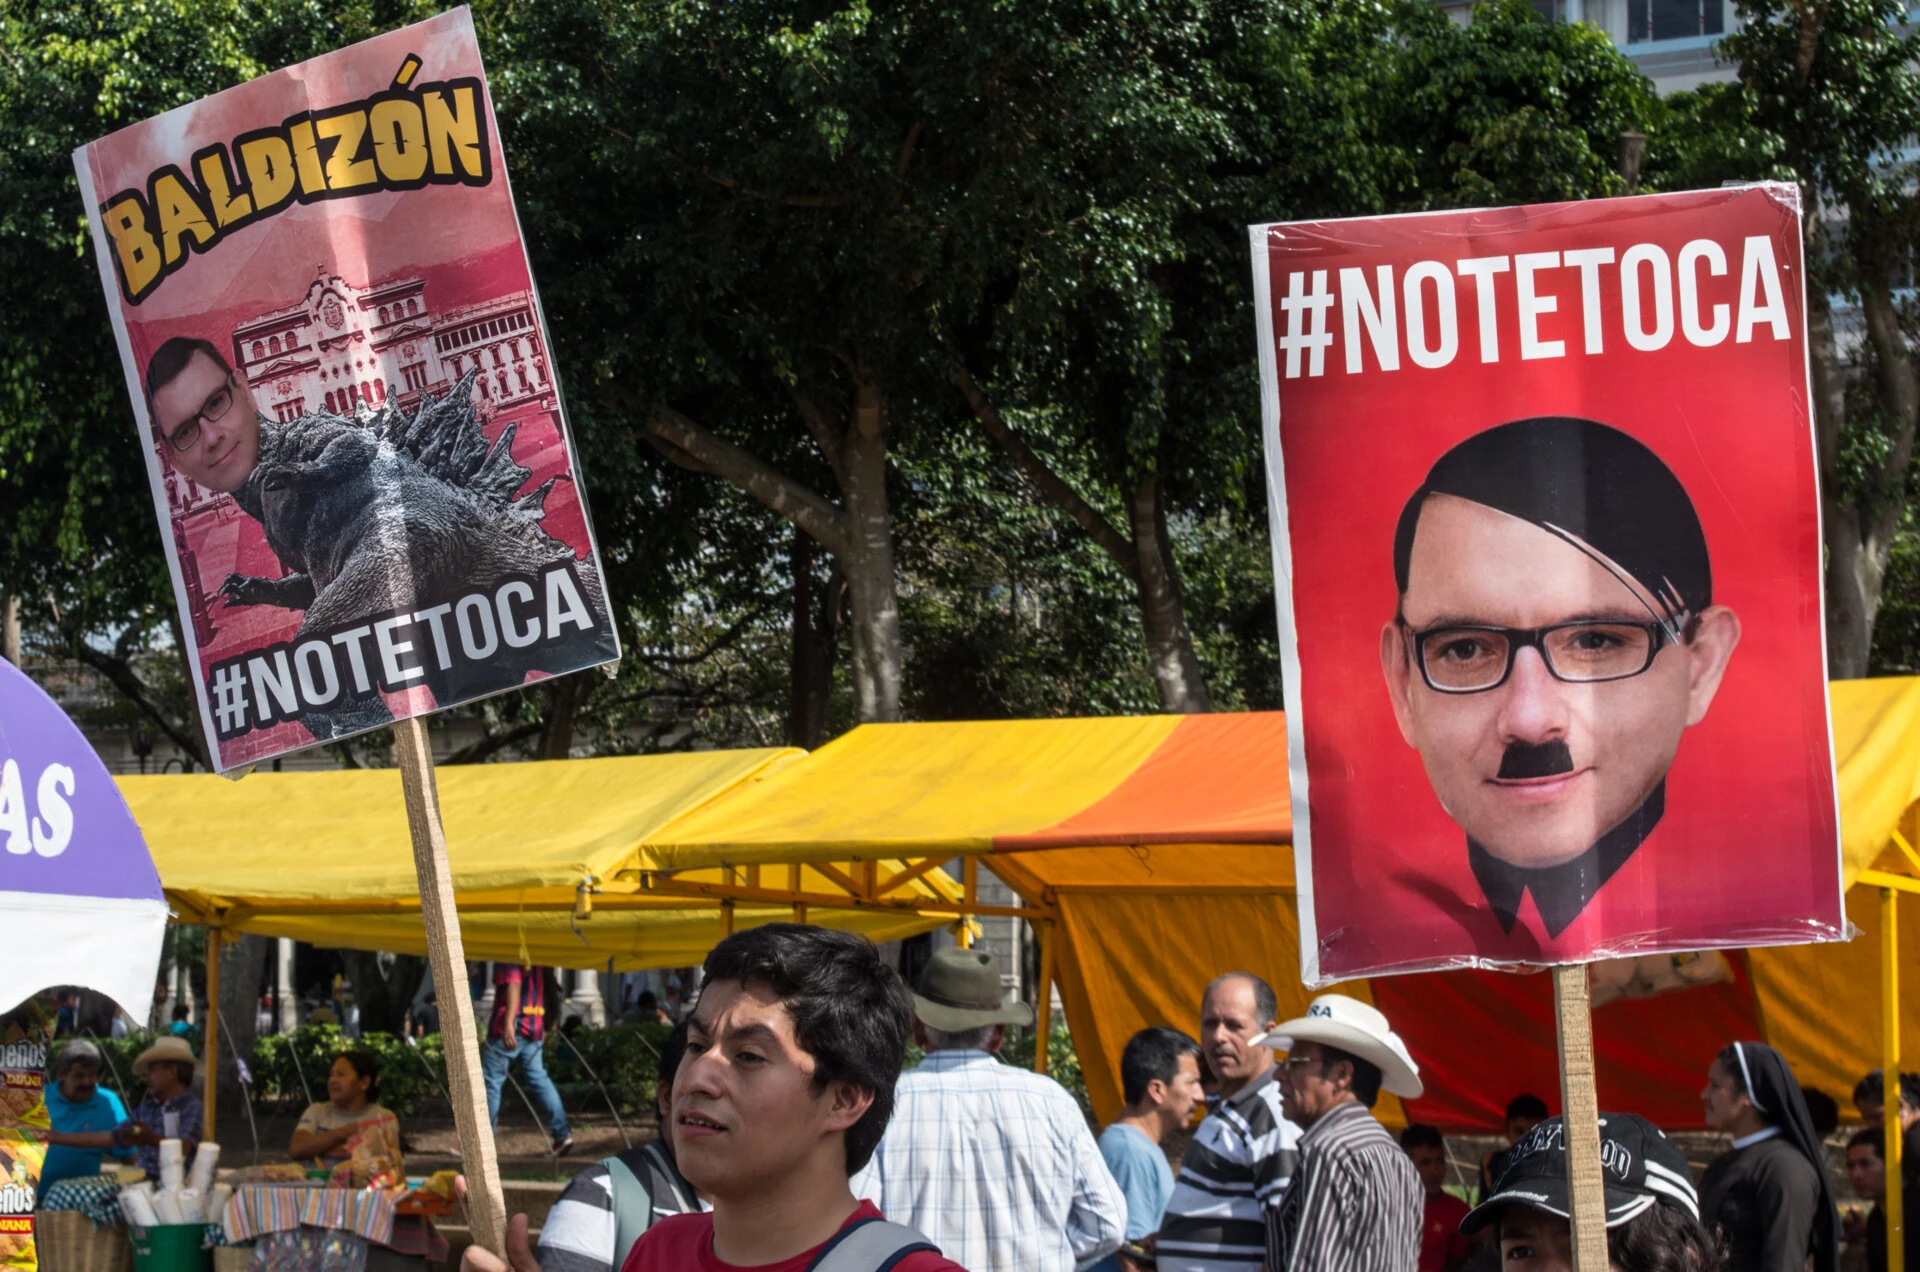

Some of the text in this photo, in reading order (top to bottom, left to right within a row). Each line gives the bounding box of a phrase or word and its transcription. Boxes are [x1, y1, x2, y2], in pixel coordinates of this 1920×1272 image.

[101, 55, 488, 303] BALDIZÓN
[1279, 235, 1791, 379] #NOTETOCA
[213, 568, 594, 733] #NOTETOCA
[0, 758, 75, 858] AS
[0, 1182, 34, 1213] ños
[0, 1219, 32, 1231] IANA
